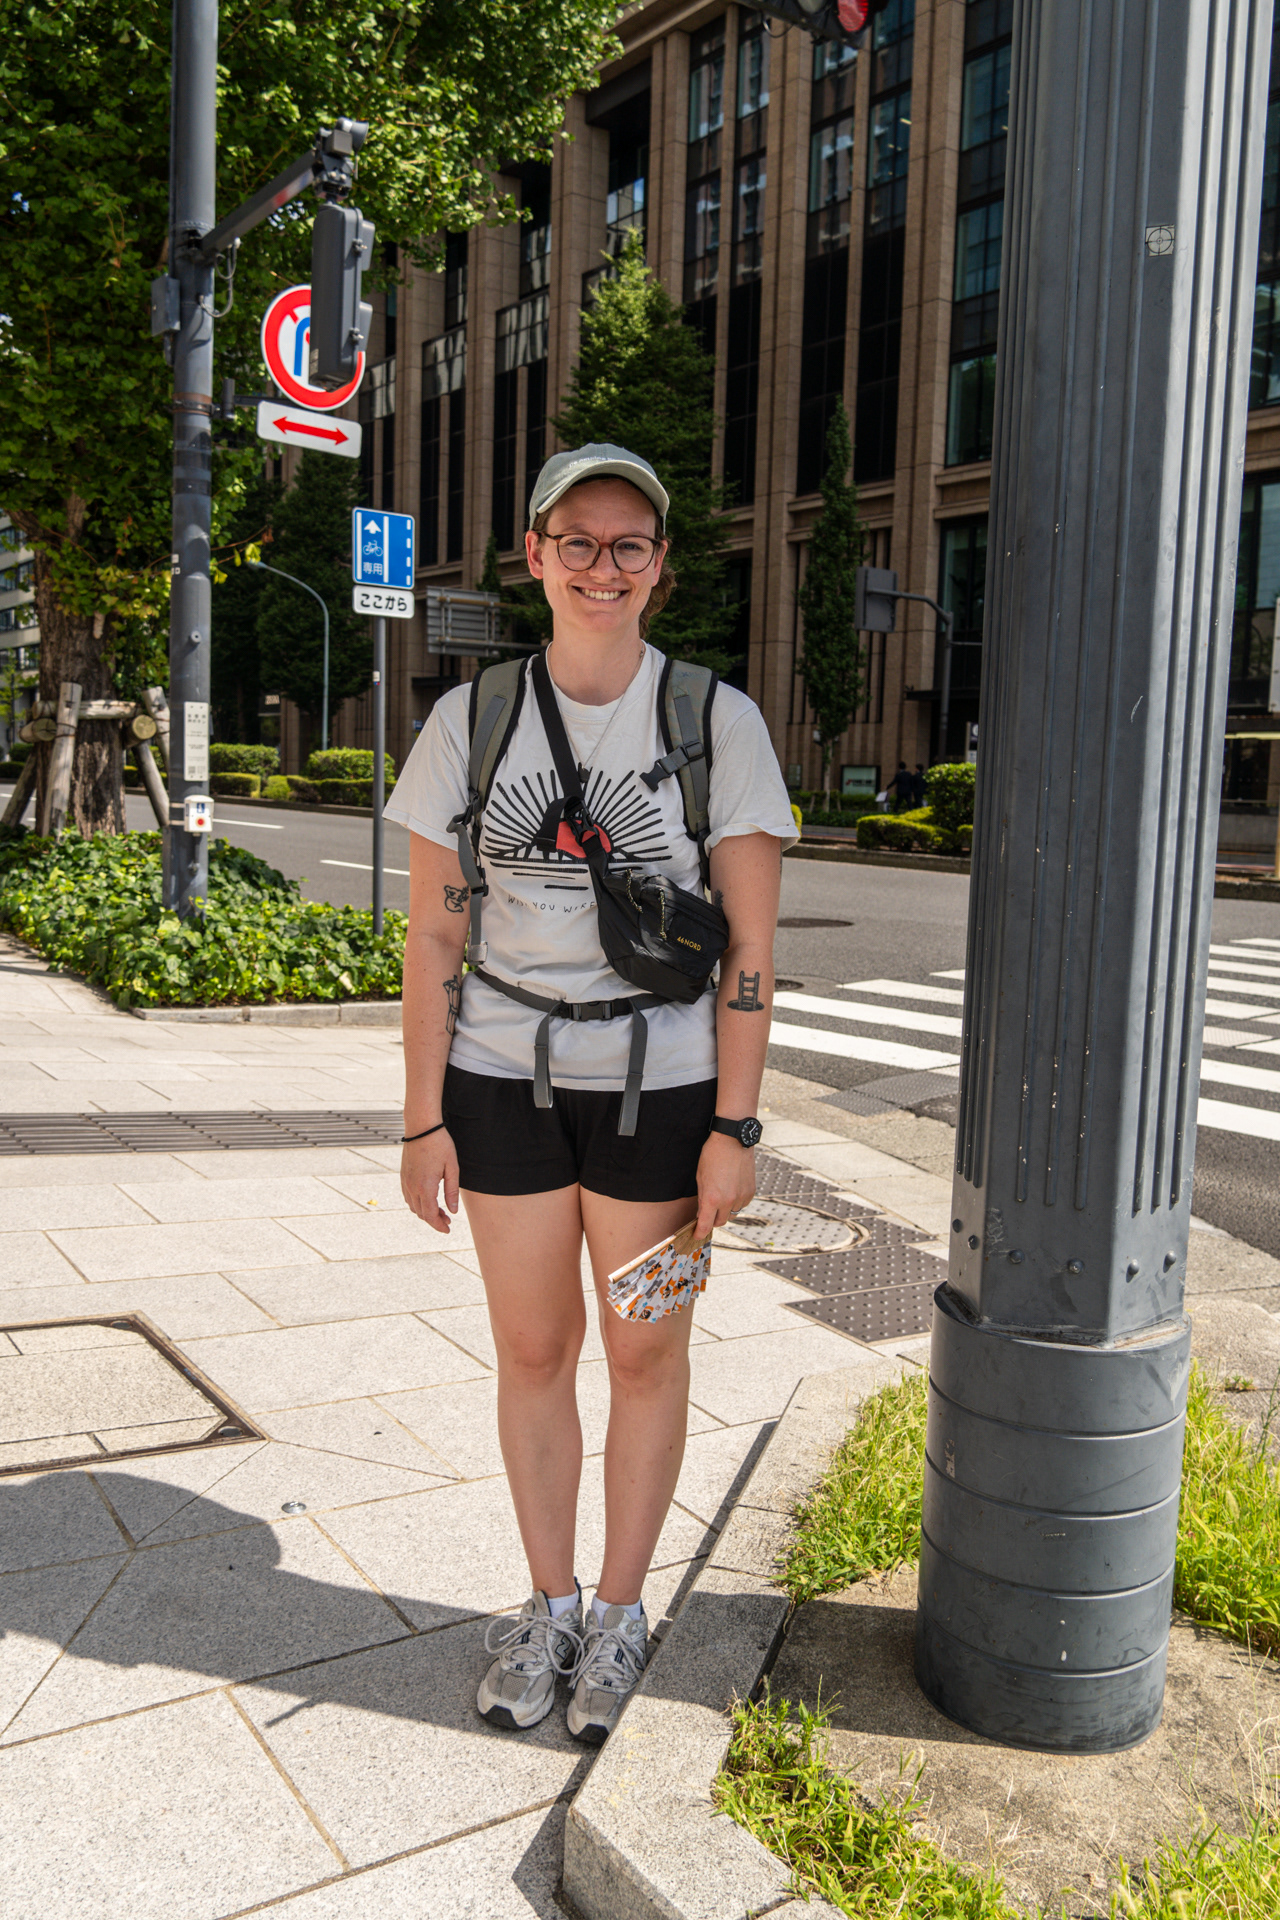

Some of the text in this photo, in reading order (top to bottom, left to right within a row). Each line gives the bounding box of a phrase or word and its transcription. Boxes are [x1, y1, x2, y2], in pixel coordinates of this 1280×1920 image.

[363, 562, 383, 575] 専用
[360, 593, 407, 611] ここから
[532, 901, 556, 911] YOU
